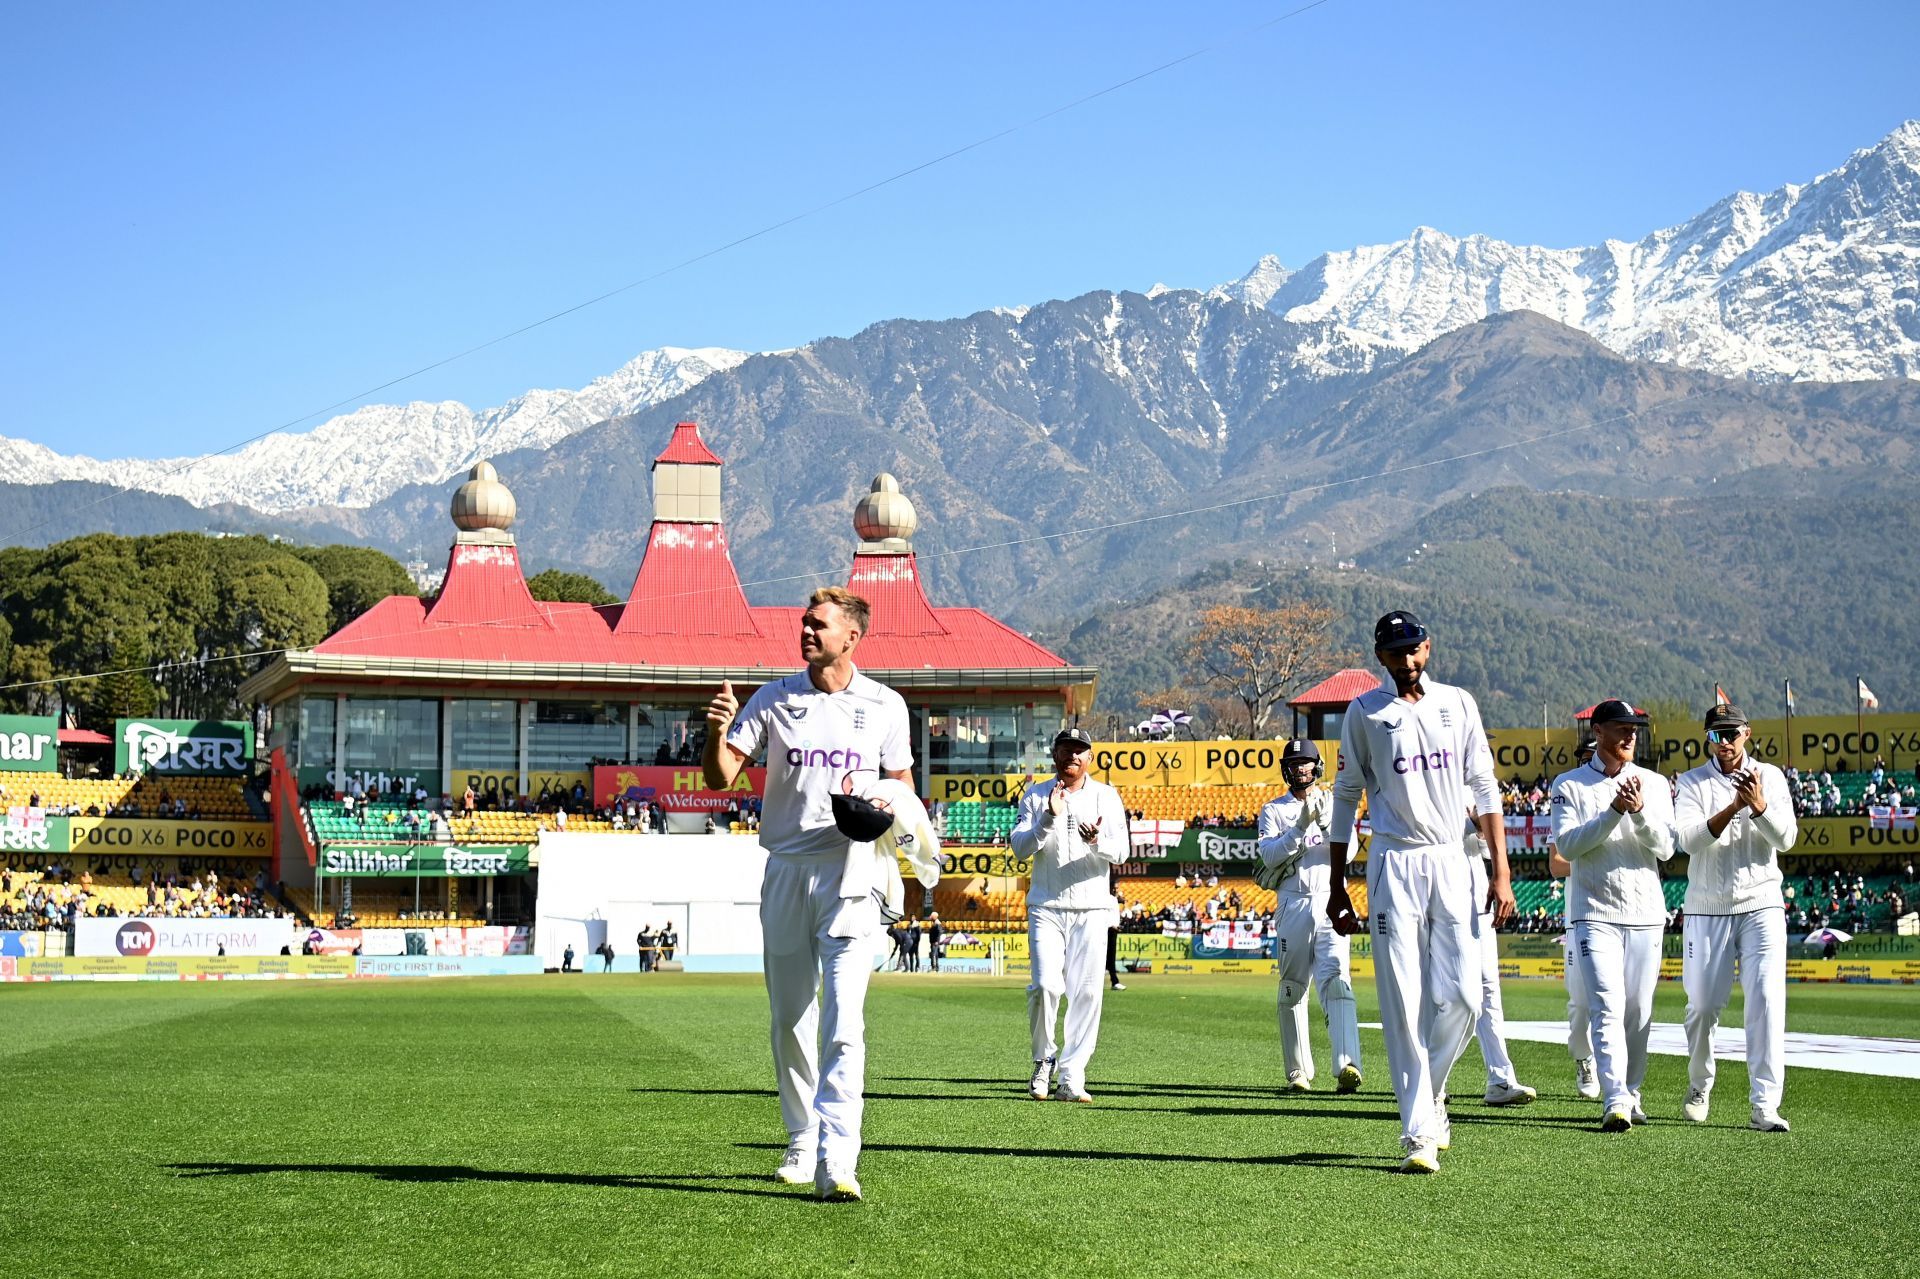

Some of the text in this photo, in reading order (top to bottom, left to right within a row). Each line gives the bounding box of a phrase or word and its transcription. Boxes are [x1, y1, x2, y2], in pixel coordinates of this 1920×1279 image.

[1751, 737, 1778, 757] X6
[1802, 732, 1879, 755] POCO
[786, 741, 862, 770] cinch
[1096, 750, 1182, 770] OCO X6
[1207, 748, 1274, 769] POCO
[1393, 748, 1454, 775] cinch
[1490, 745, 1530, 767] CO
[1541, 746, 1568, 766] X6
[945, 779, 1007, 798] POCO
[661, 793, 730, 808] Welcome
[73, 827, 267, 848] POCO X6 POCO X6
[1197, 831, 1261, 861] शिख
[1803, 825, 1920, 846] X6 POCO
[326, 848, 412, 874] Shikhar
[942, 853, 991, 874] OCO
[158, 932, 257, 949] PLATFORM
[1836, 936, 1915, 953] ncredible
[377, 961, 462, 972] IDFC FIRST Bank
